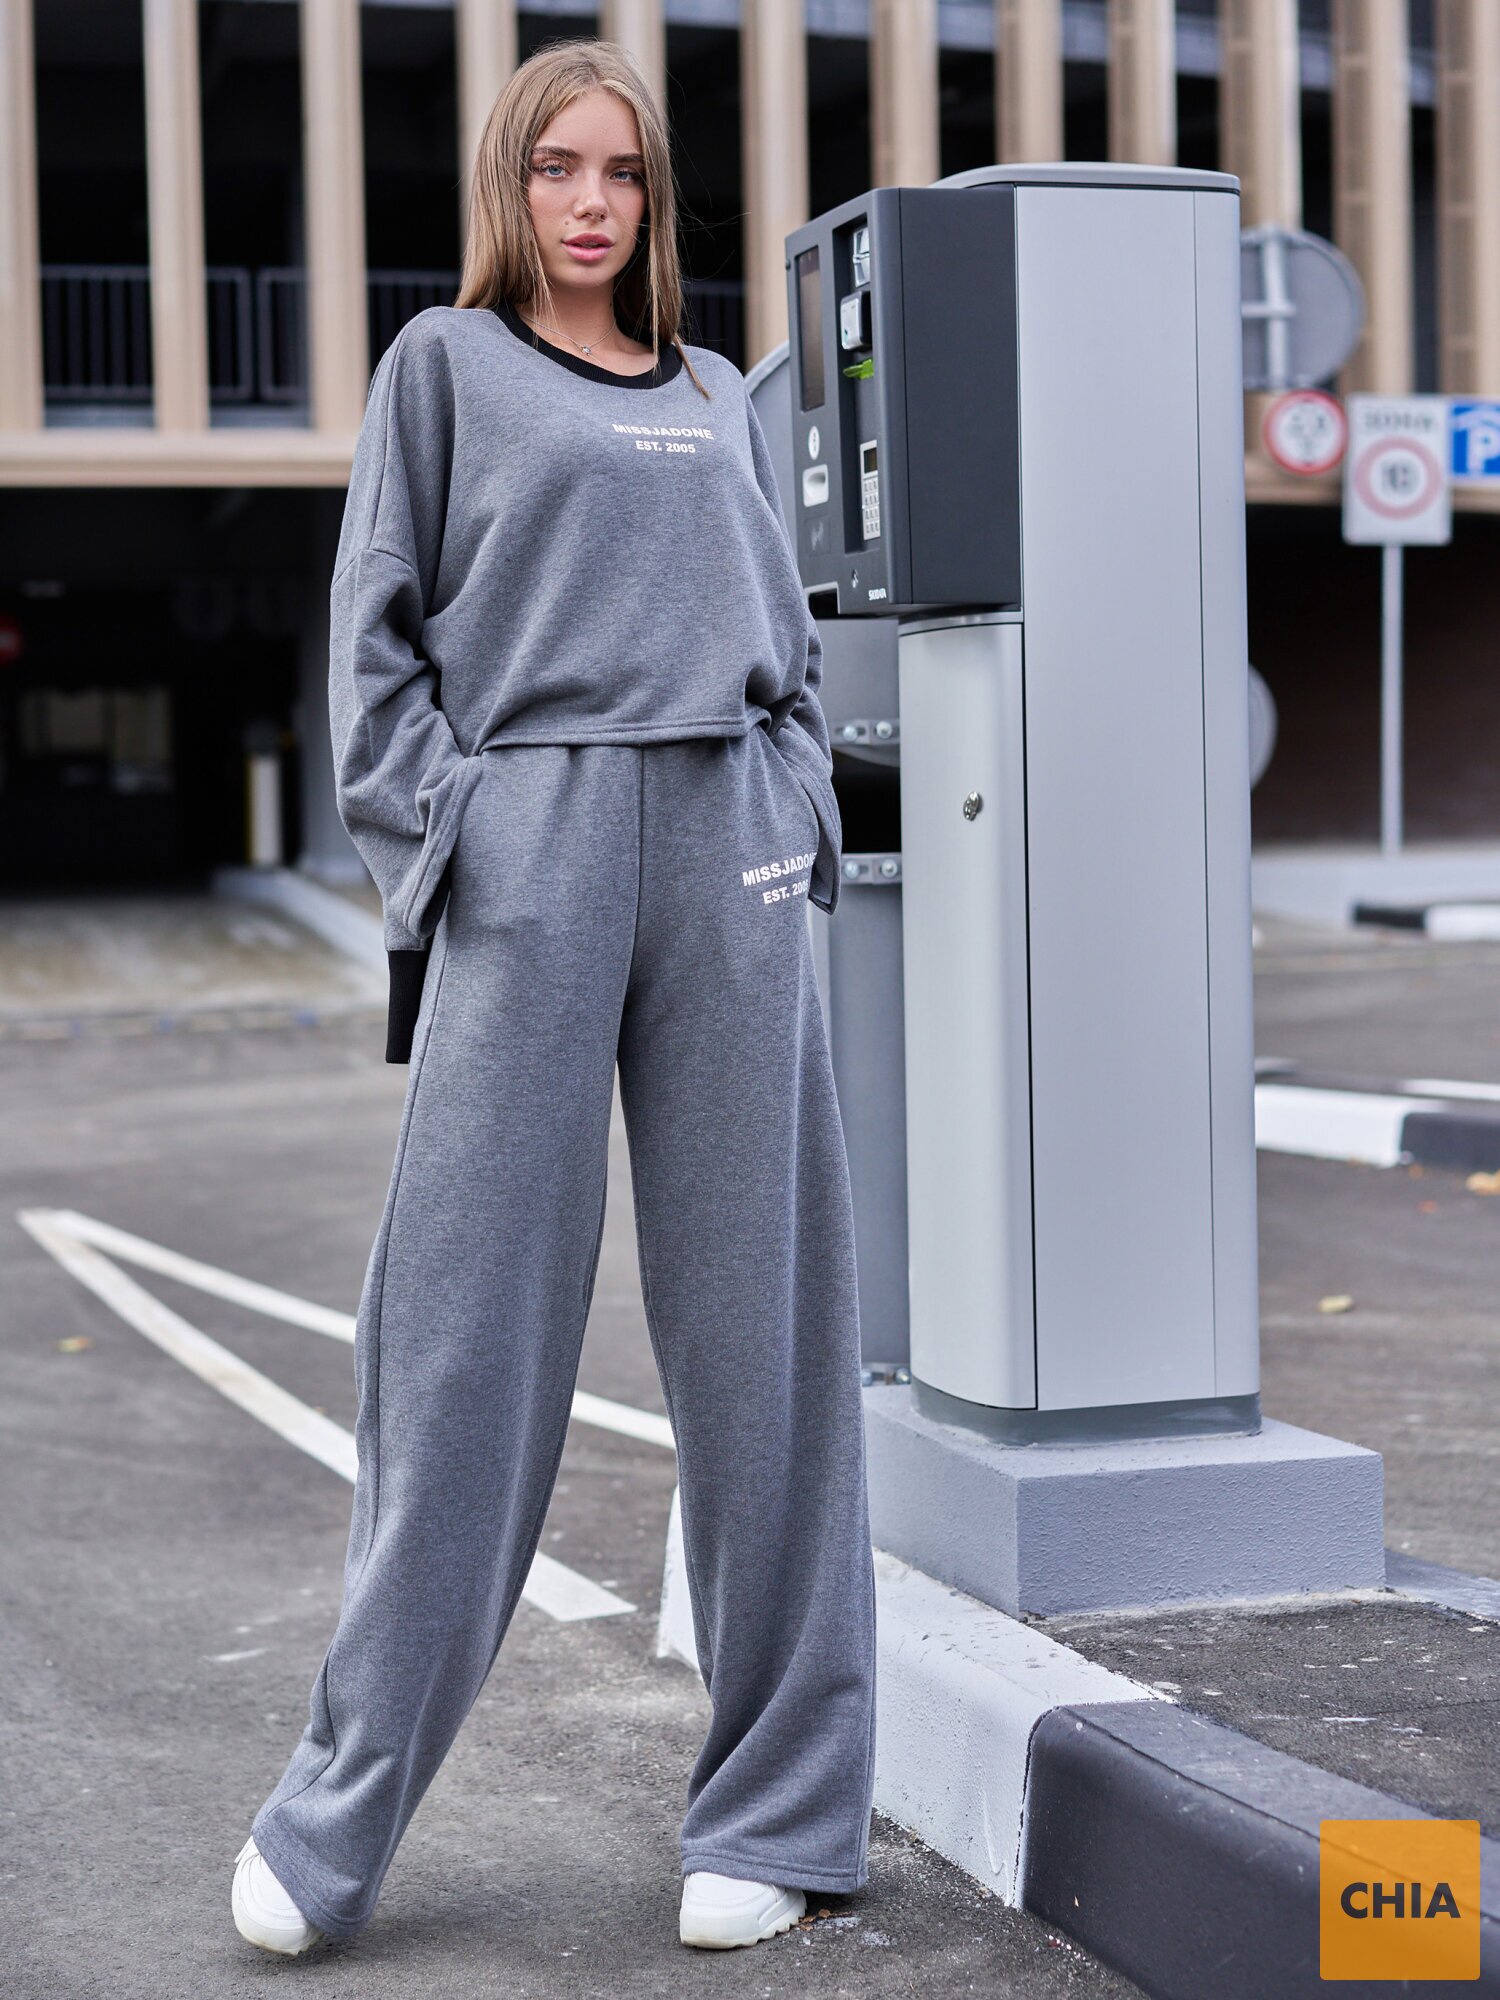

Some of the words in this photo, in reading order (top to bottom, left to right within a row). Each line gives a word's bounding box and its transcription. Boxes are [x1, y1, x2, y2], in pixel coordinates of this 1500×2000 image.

[612, 424, 714, 440] MISSJADONE
[635, 440, 661, 452] EST.
[666, 442, 696, 453] 2005
[762, 886, 790, 904] EST.
